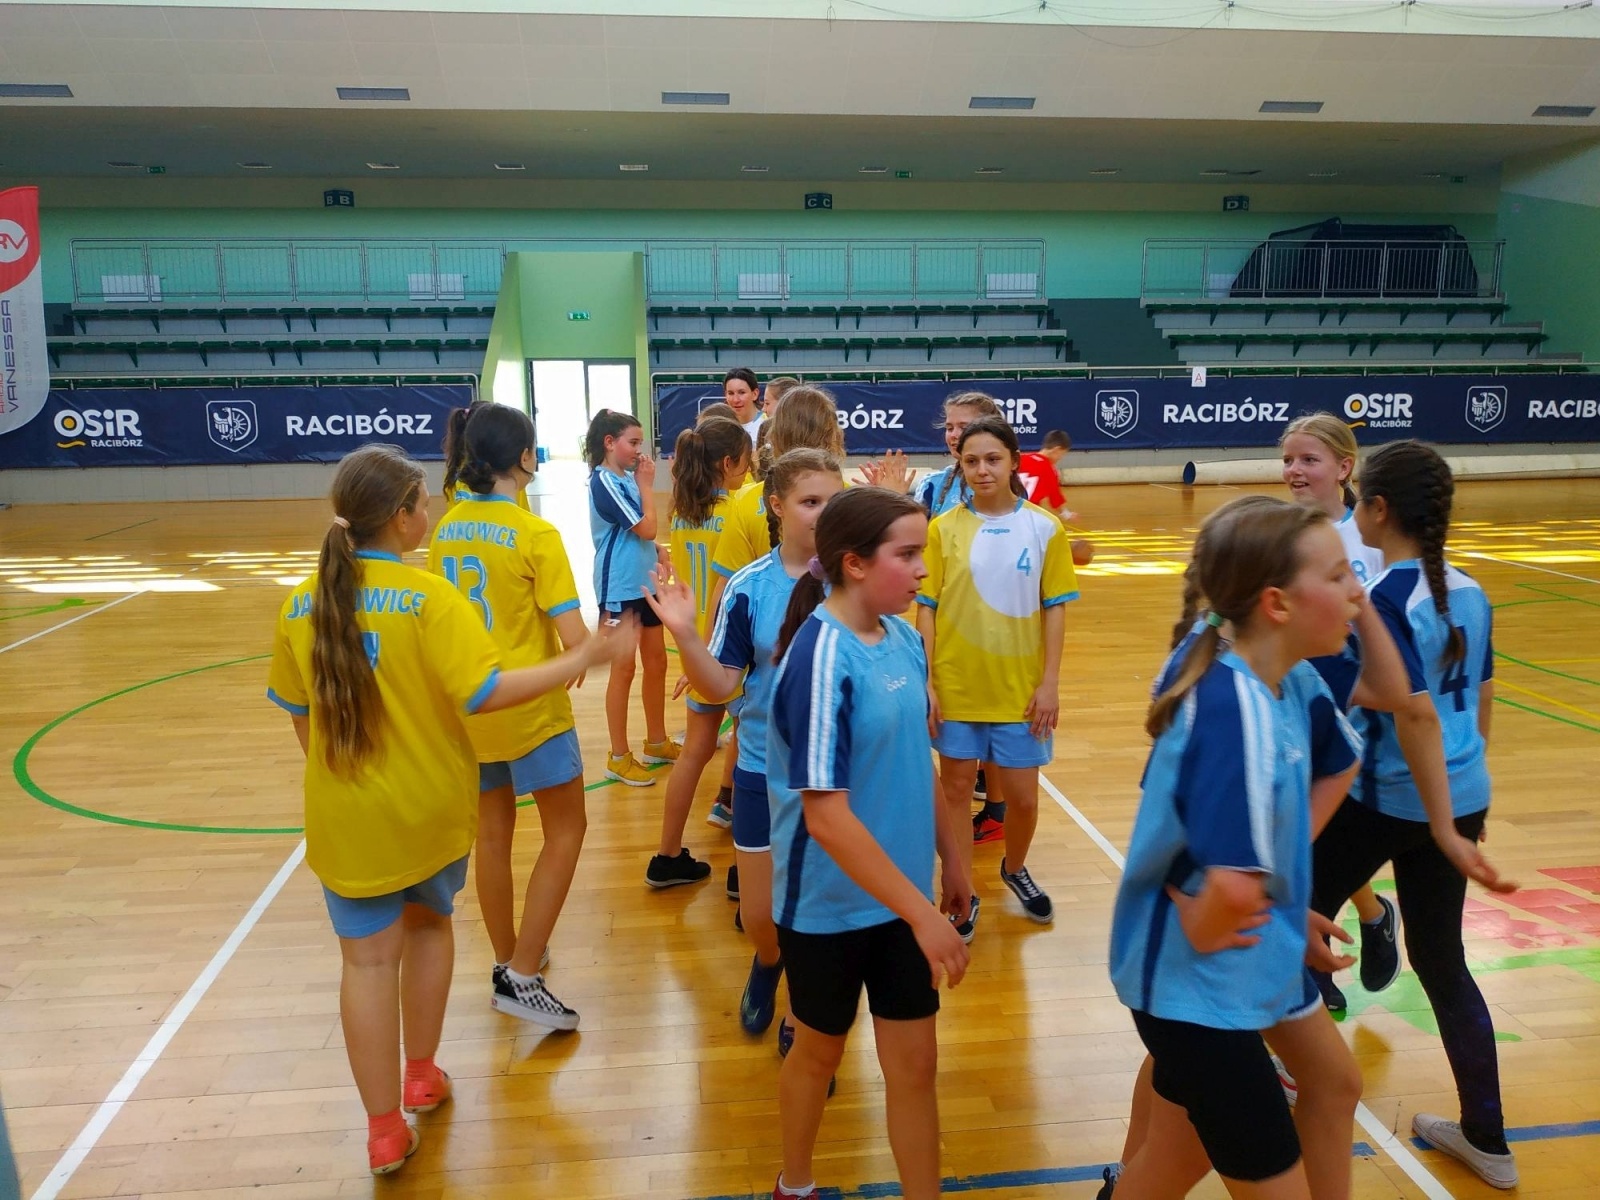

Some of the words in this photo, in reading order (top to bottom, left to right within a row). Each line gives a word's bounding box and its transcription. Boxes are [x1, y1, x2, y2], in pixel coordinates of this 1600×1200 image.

[326, 195, 334, 205] B
[340, 195, 350, 205] B
[808, 198, 817, 208] C
[823, 198, 831, 208] C
[1227, 200, 1239, 209] D
[1, 300, 19, 413] VANESSA
[1195, 373, 1203, 383] A
[1163, 397, 1289, 423] RACIBÓRZ
[1528, 399, 1600, 418] RACIB
[286, 407, 433, 436] RACIBÓRZ
[1370, 419, 1412, 428] RACIBÓRZ
[91, 437, 143, 447] RACIBÓRZ
[1016, 547, 1031, 577] 4
[285, 586, 427, 620] JAWICE
